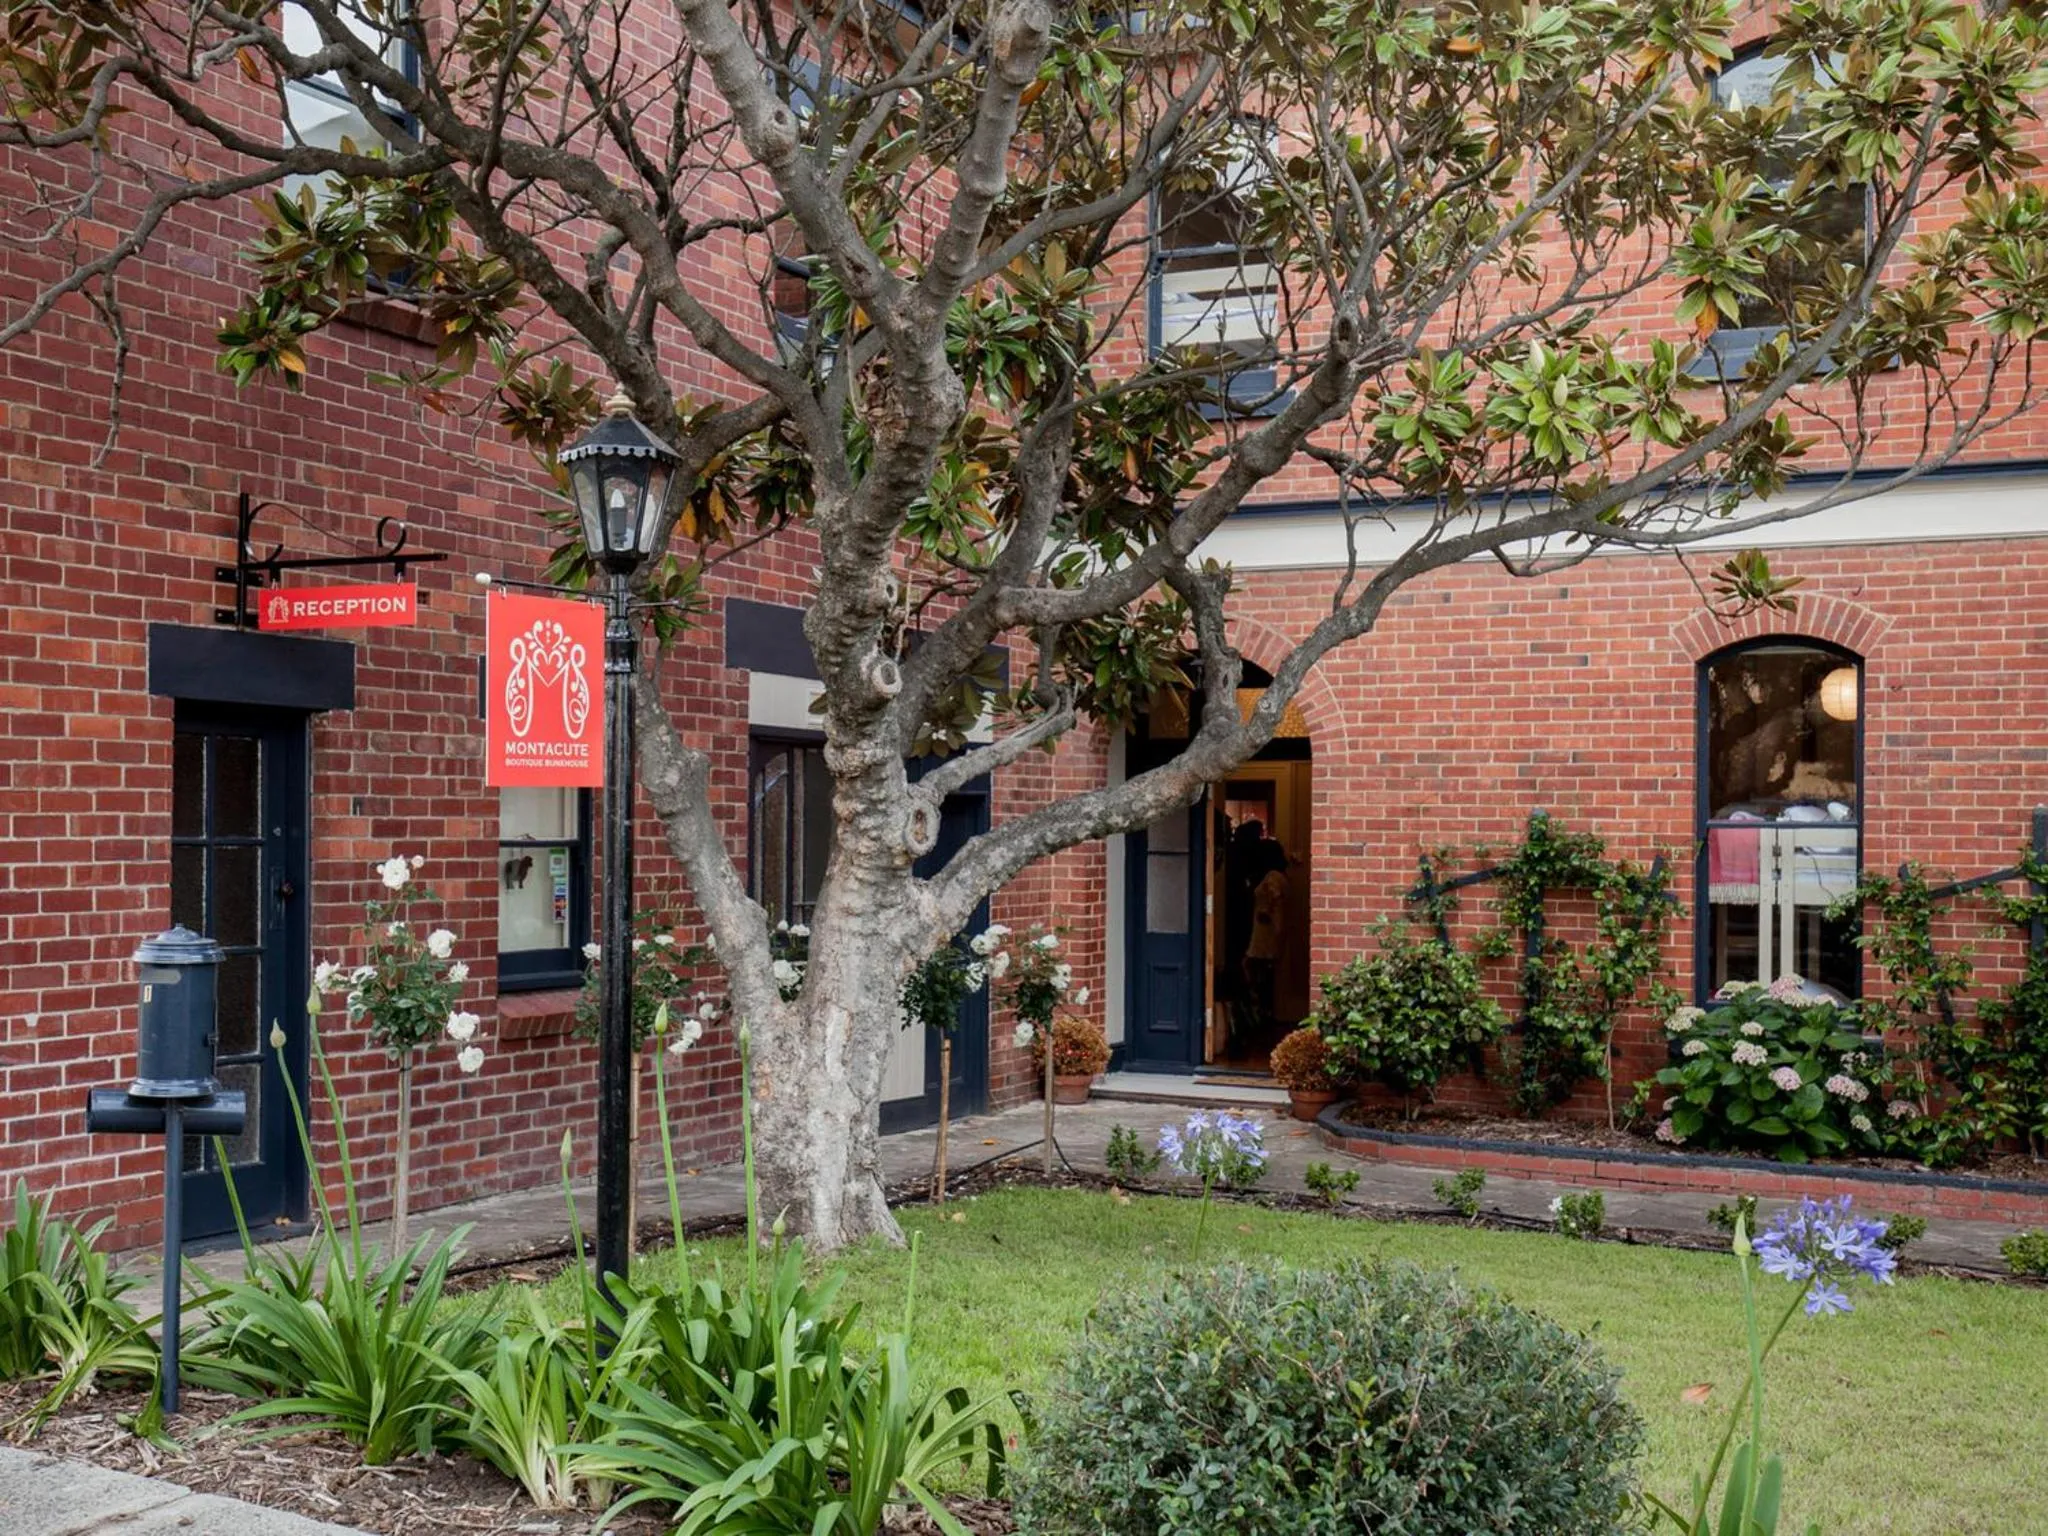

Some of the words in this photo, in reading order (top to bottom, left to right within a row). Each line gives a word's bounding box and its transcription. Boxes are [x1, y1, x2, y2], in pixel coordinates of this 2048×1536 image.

[293, 596, 407, 617] RECEPTION
[505, 741, 589, 756] MONTACUTE
[505, 758, 544, 767] BOUTIQUE
[545, 759, 589, 768] BUNKHOUSE
